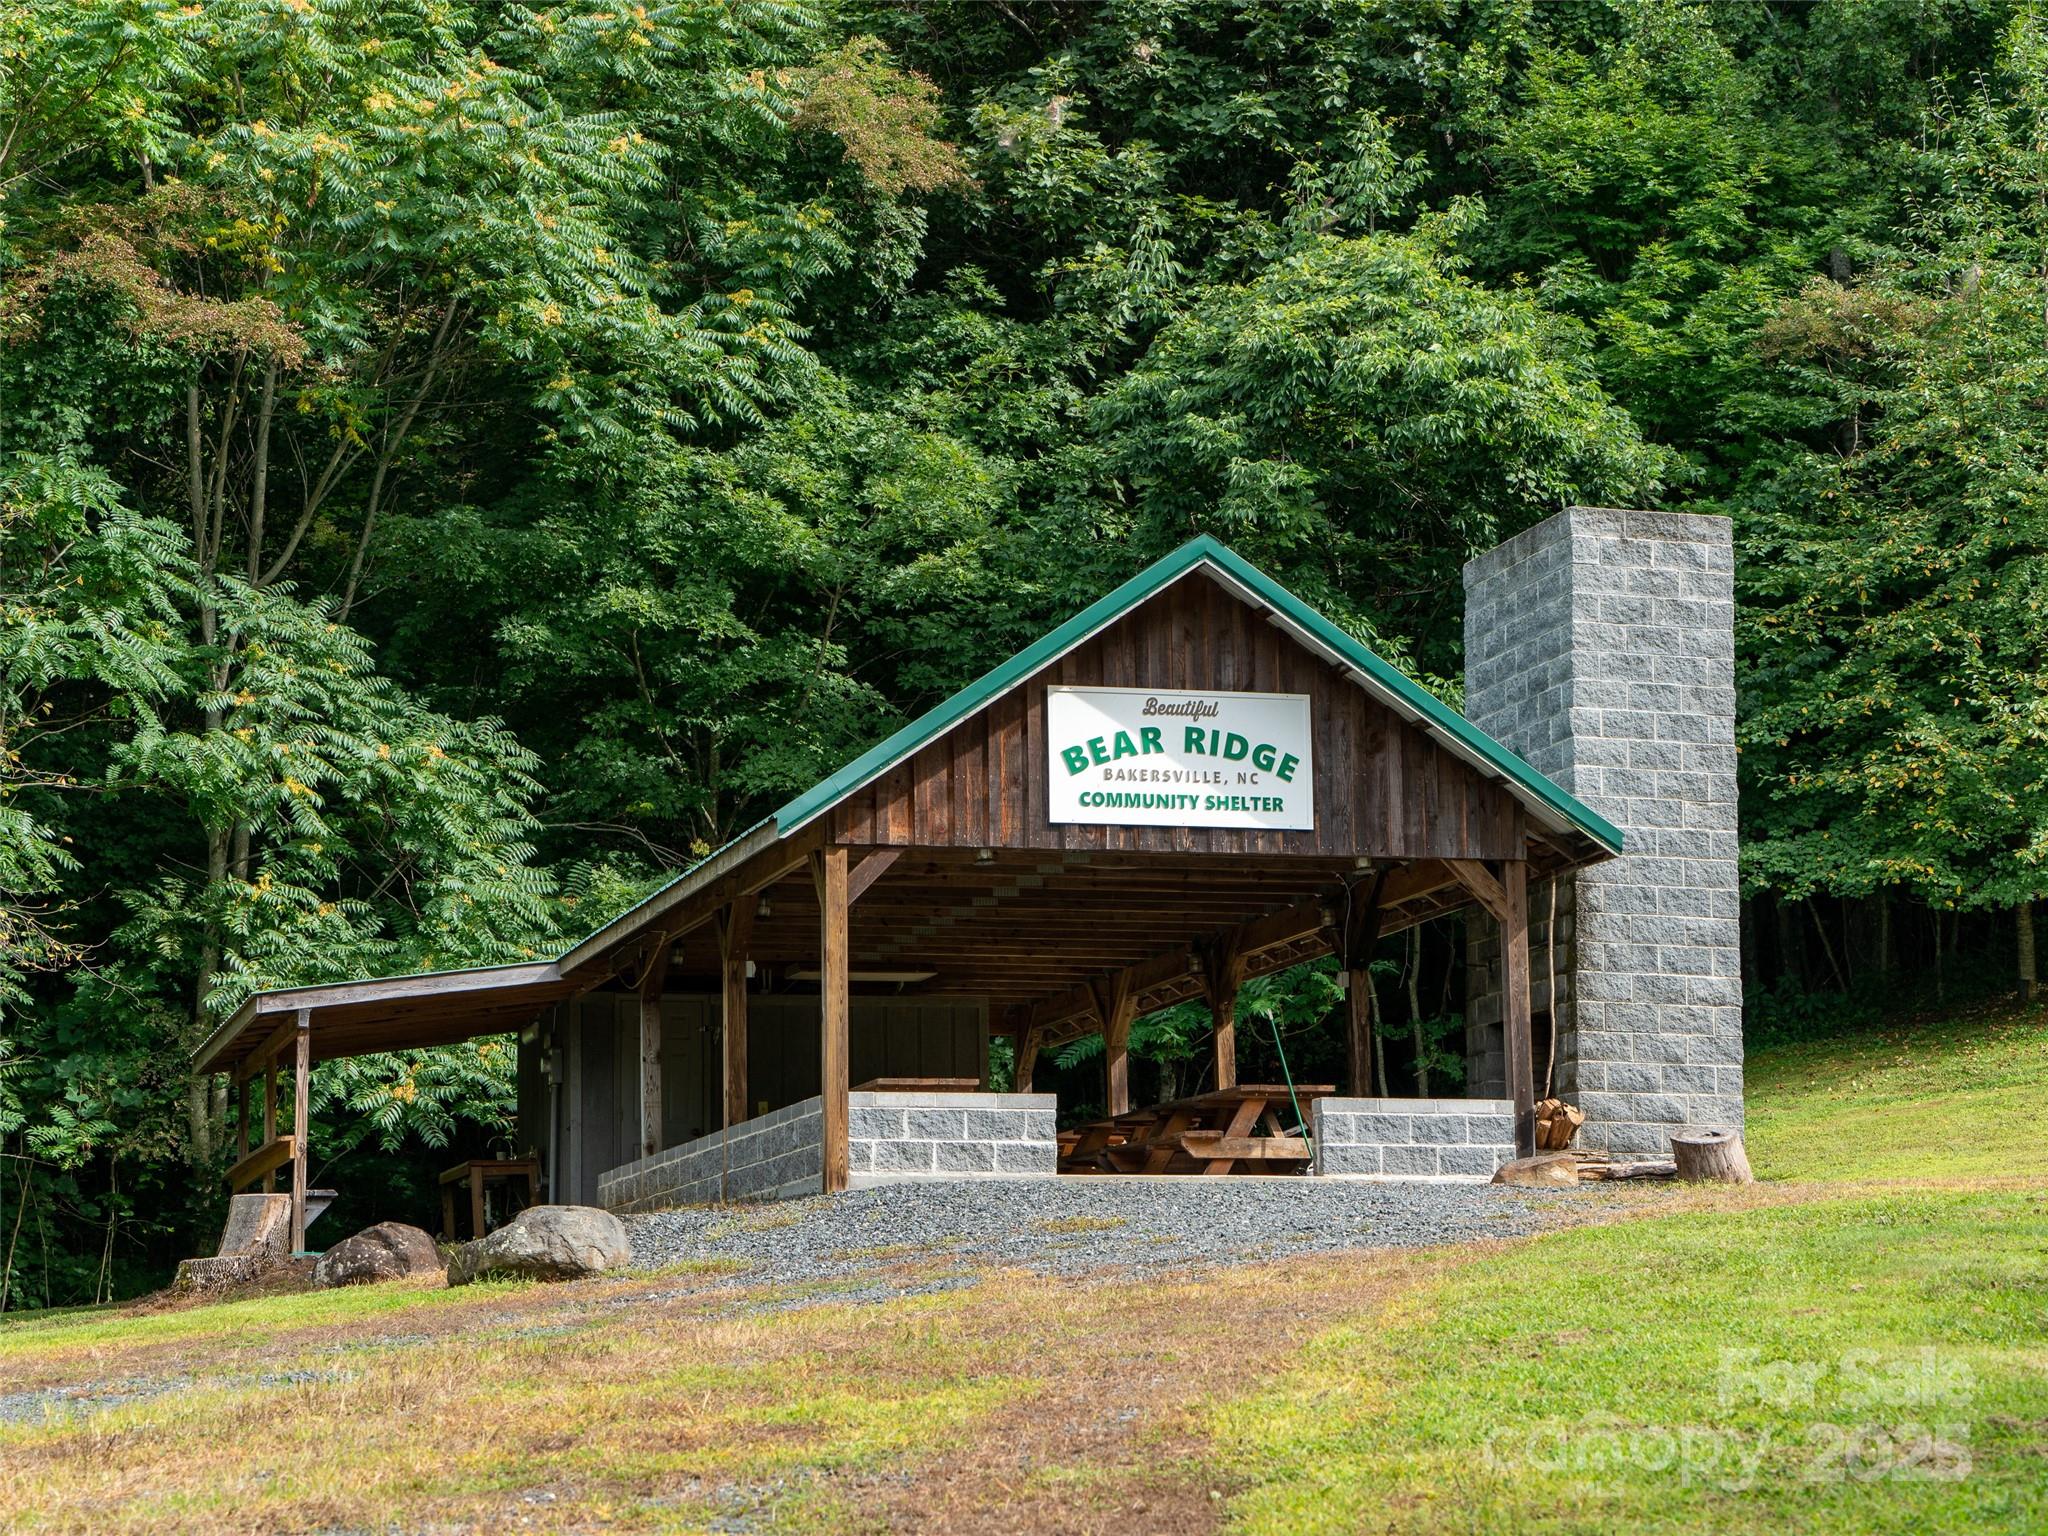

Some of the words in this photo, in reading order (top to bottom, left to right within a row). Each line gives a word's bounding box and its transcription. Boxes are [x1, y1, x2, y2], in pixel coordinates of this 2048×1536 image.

[1142, 697, 1219, 722] Beautiful
[1061, 726, 1164, 777] BEAR
[1184, 726, 1300, 783] RIDGE
[1103, 767, 1229, 785] BAKERSVILLE,
[1237, 772, 1259, 785] NC
[1079, 791, 1199, 810] COMMUNITY
[1205, 795, 1284, 812] SHELTER
